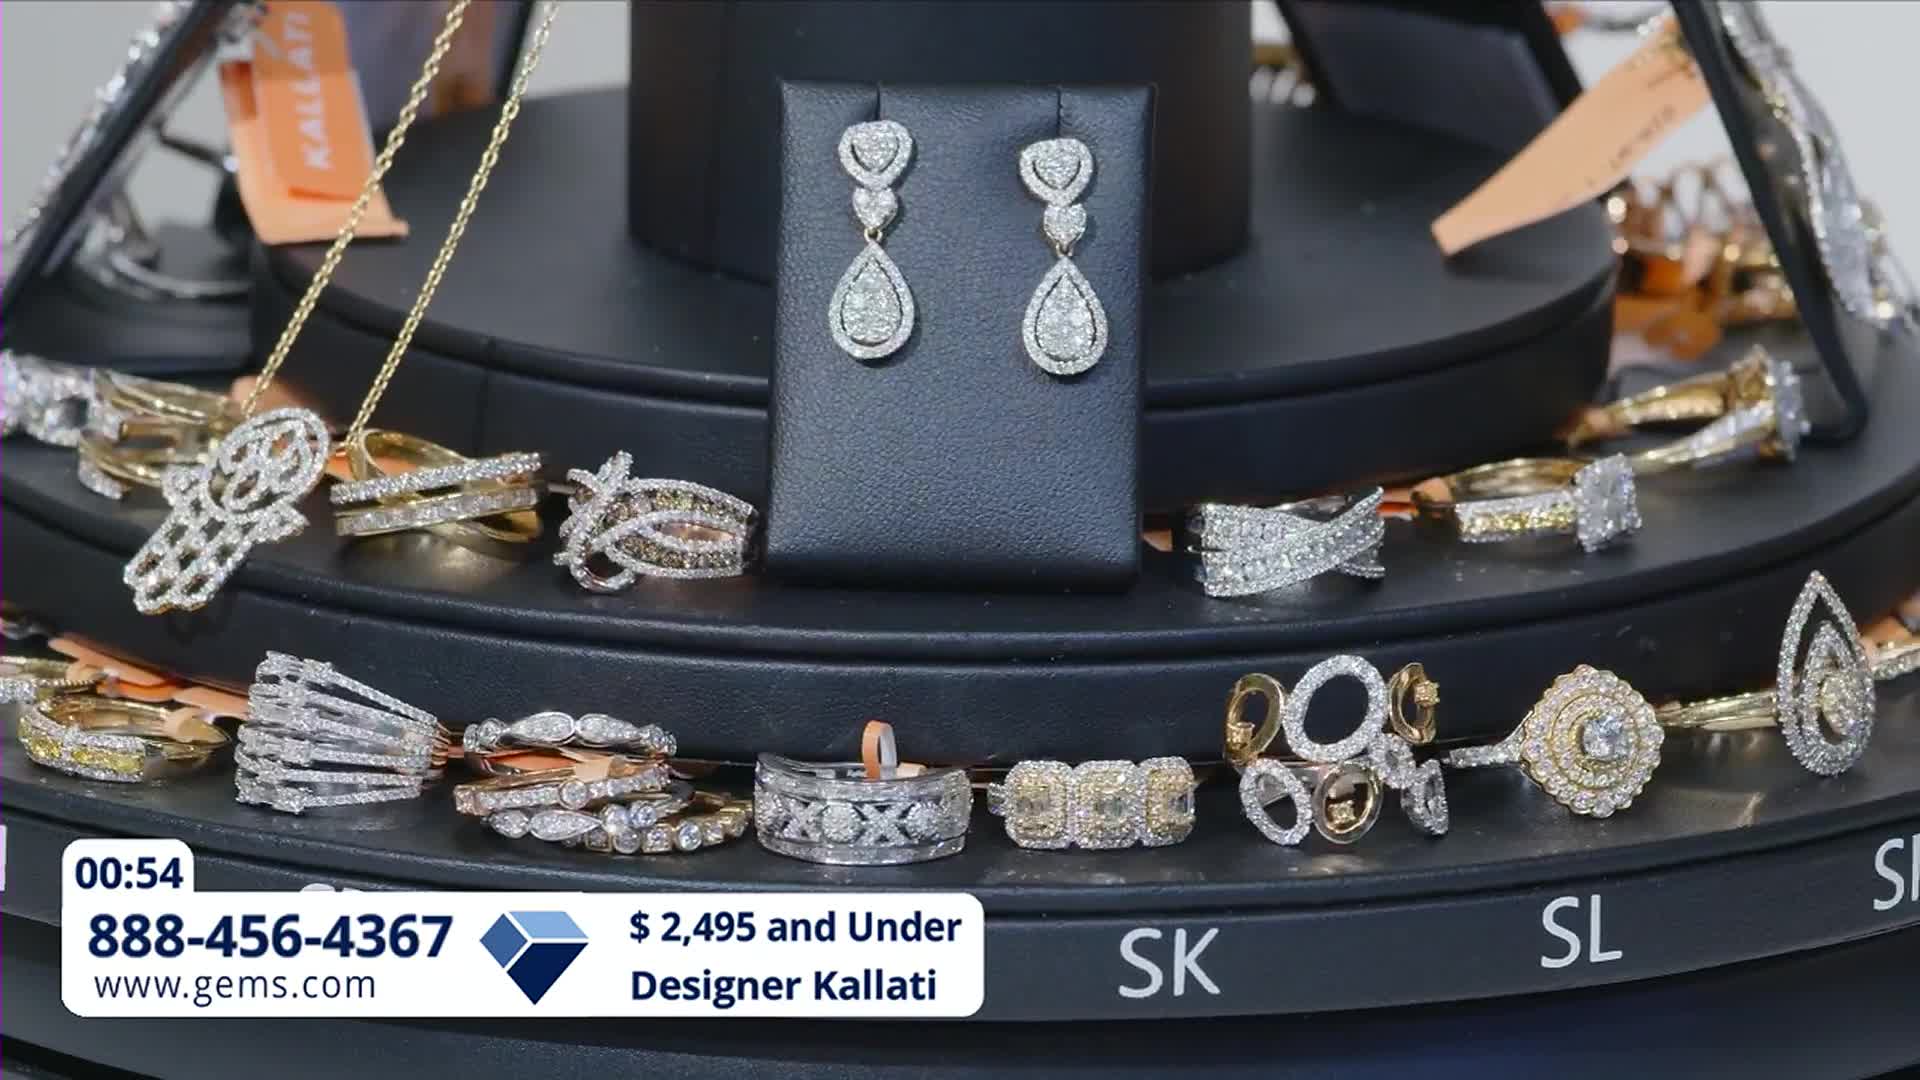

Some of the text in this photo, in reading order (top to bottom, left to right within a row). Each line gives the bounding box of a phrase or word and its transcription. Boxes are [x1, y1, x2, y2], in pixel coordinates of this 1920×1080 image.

[283, 12, 333, 170] KALLATI
[1873, 833, 1920, 910] S
[1118, 928, 1221, 998] SK
[1540, 895, 1623, 968] SL
